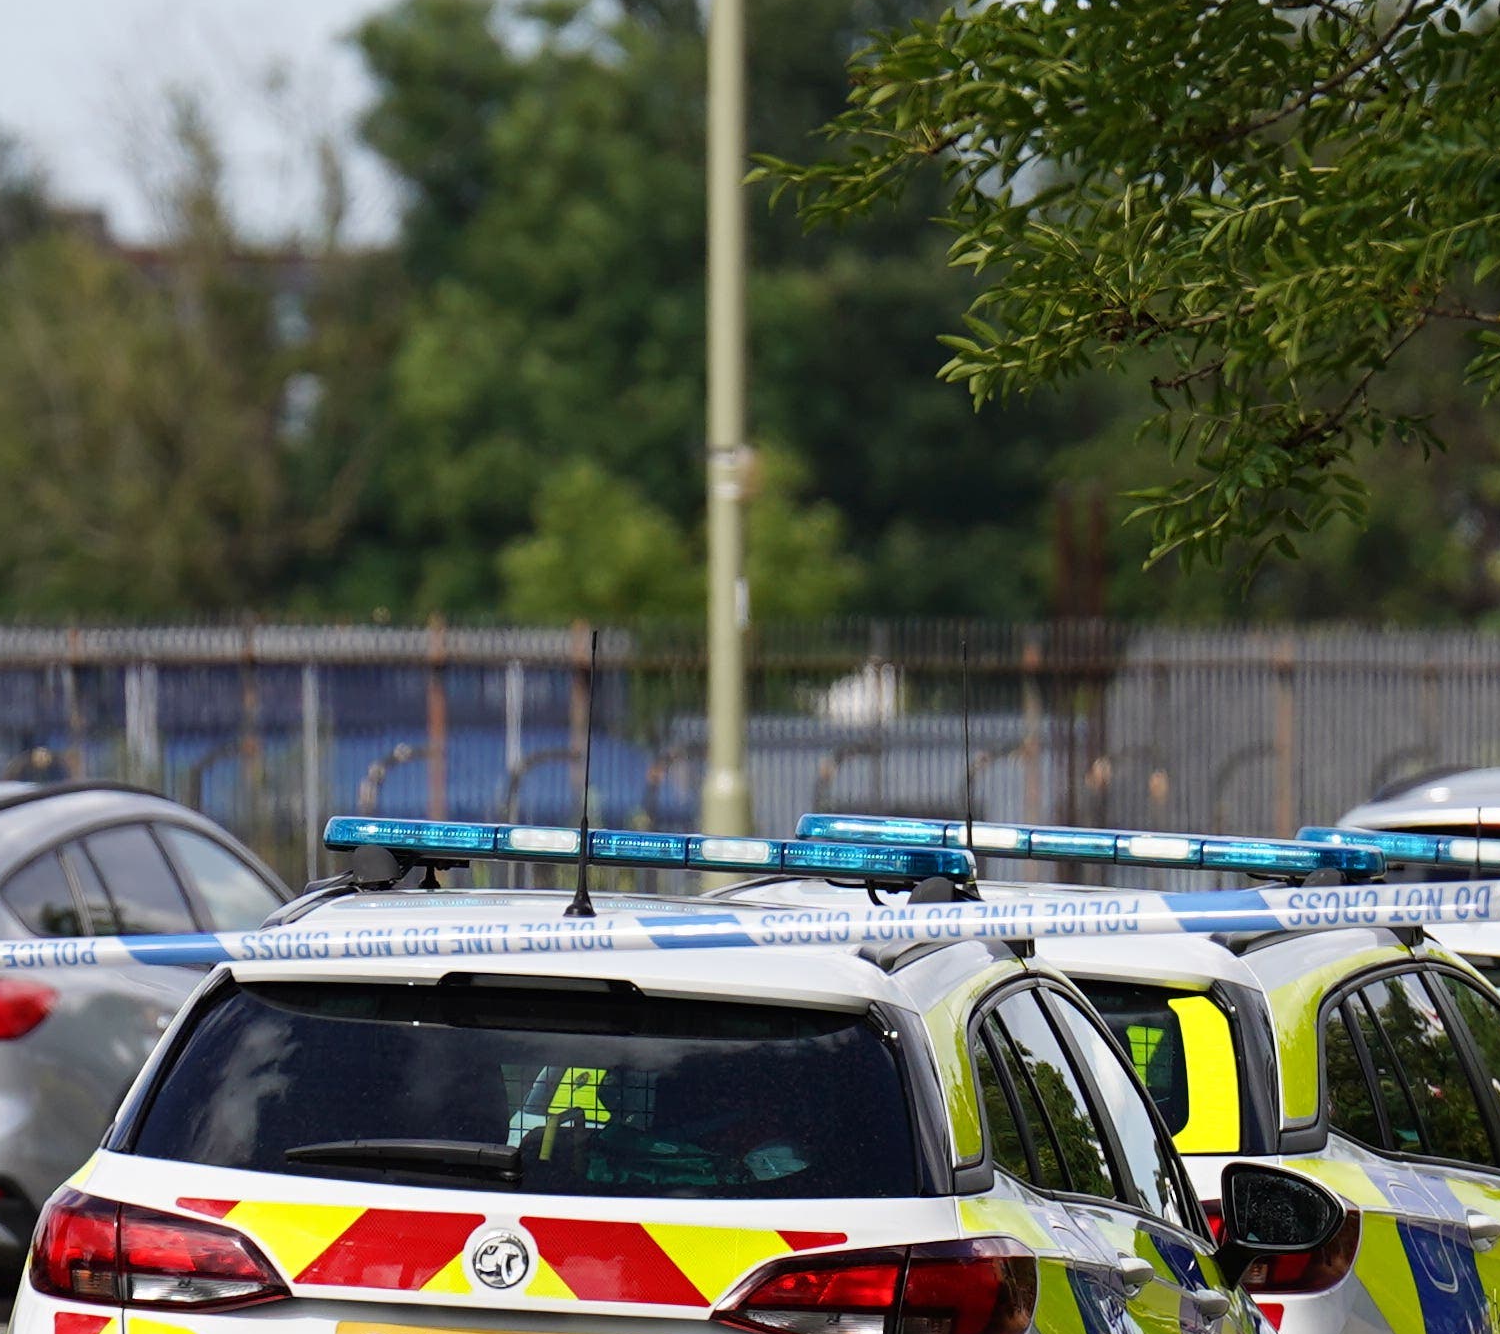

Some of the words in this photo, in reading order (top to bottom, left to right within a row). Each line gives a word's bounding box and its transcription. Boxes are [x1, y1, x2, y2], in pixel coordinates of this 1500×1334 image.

[1044, 900, 1139, 935] POLICE
[1286, 890, 1379, 926] CROSS
[1389, 887, 1443, 921] NOT
[1454, 886, 1490, 919] DO
[519, 919, 615, 951] POLICE
[760, 910, 850, 945] CROSS
[861, 909, 915, 940] NOT
[925, 907, 962, 938] DO
[973, 905, 1033, 937] LINE
[3, 940, 98, 967] POLICE
[240, 932, 330, 960] CROSS
[340, 930, 393, 957] NOT
[403, 928, 439, 957] DO
[451, 923, 508, 954] LINE
